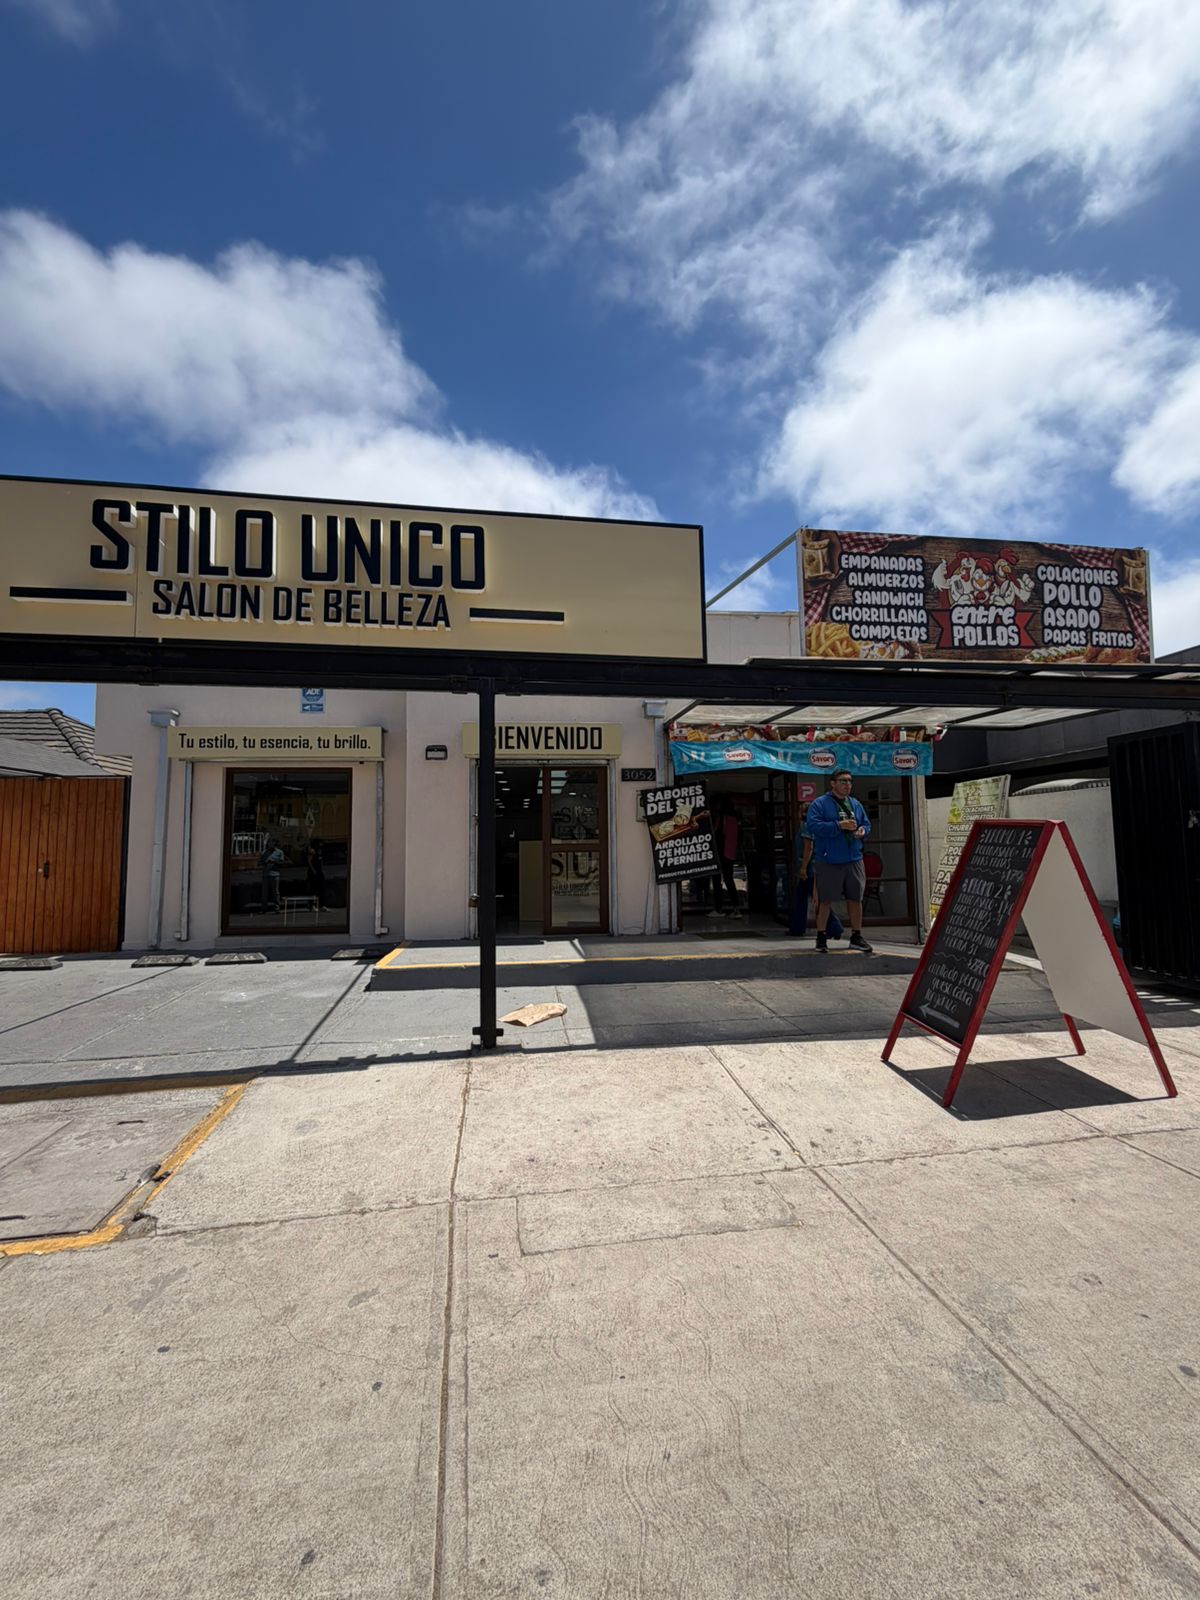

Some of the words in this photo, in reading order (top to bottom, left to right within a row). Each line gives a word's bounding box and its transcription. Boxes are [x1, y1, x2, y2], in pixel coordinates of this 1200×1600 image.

[90, 499, 274, 578] STILO
[301, 514, 486, 590] UNICO
[840, 555, 924, 572] EMPANADAS
[848, 573, 925, 589] ALMUERZOS
[1036, 565, 1119, 586] COLACIONES
[152, 579, 261, 619] SALON
[272, 587, 313, 622] DE
[323, 589, 451, 628] BELLEZA
[854, 590, 924, 607] SANDWICH
[1043, 583, 1102, 607] POLLO
[831, 606, 928, 624] CHORRILLANA
[951, 606, 1016, 625] entre
[1043, 607, 1100, 629] ASADO
[851, 625, 928, 641] COMPLETOS
[952, 625, 1020, 647] POLLOS
[1043, 629, 1087, 645] PAPAS
[1092, 631, 1134, 647] FRITAS
[178, 733, 194, 749] Tu
[199, 733, 238, 750] estilo,
[243, 736, 256, 749] tu
[260, 735, 313, 750] esencia,
[317, 736, 330, 749] tu
[334, 734, 371, 749] brillo.
[494, 726, 603, 750] IENVENIDO
[811, 754, 835, 764] Savory
[894, 756, 917, 766] Savory
[647, 785, 703, 803] SABORES
[646, 801, 674, 816] DEL
[675, 795, 706, 810] SUR
[655, 834, 712, 850] ARROLLADO
[659, 848, 673, 859] DE
[673, 842, 710, 857] HUASO
[658, 859, 667, 868] Y
[667, 851, 714, 867] PERNILES
